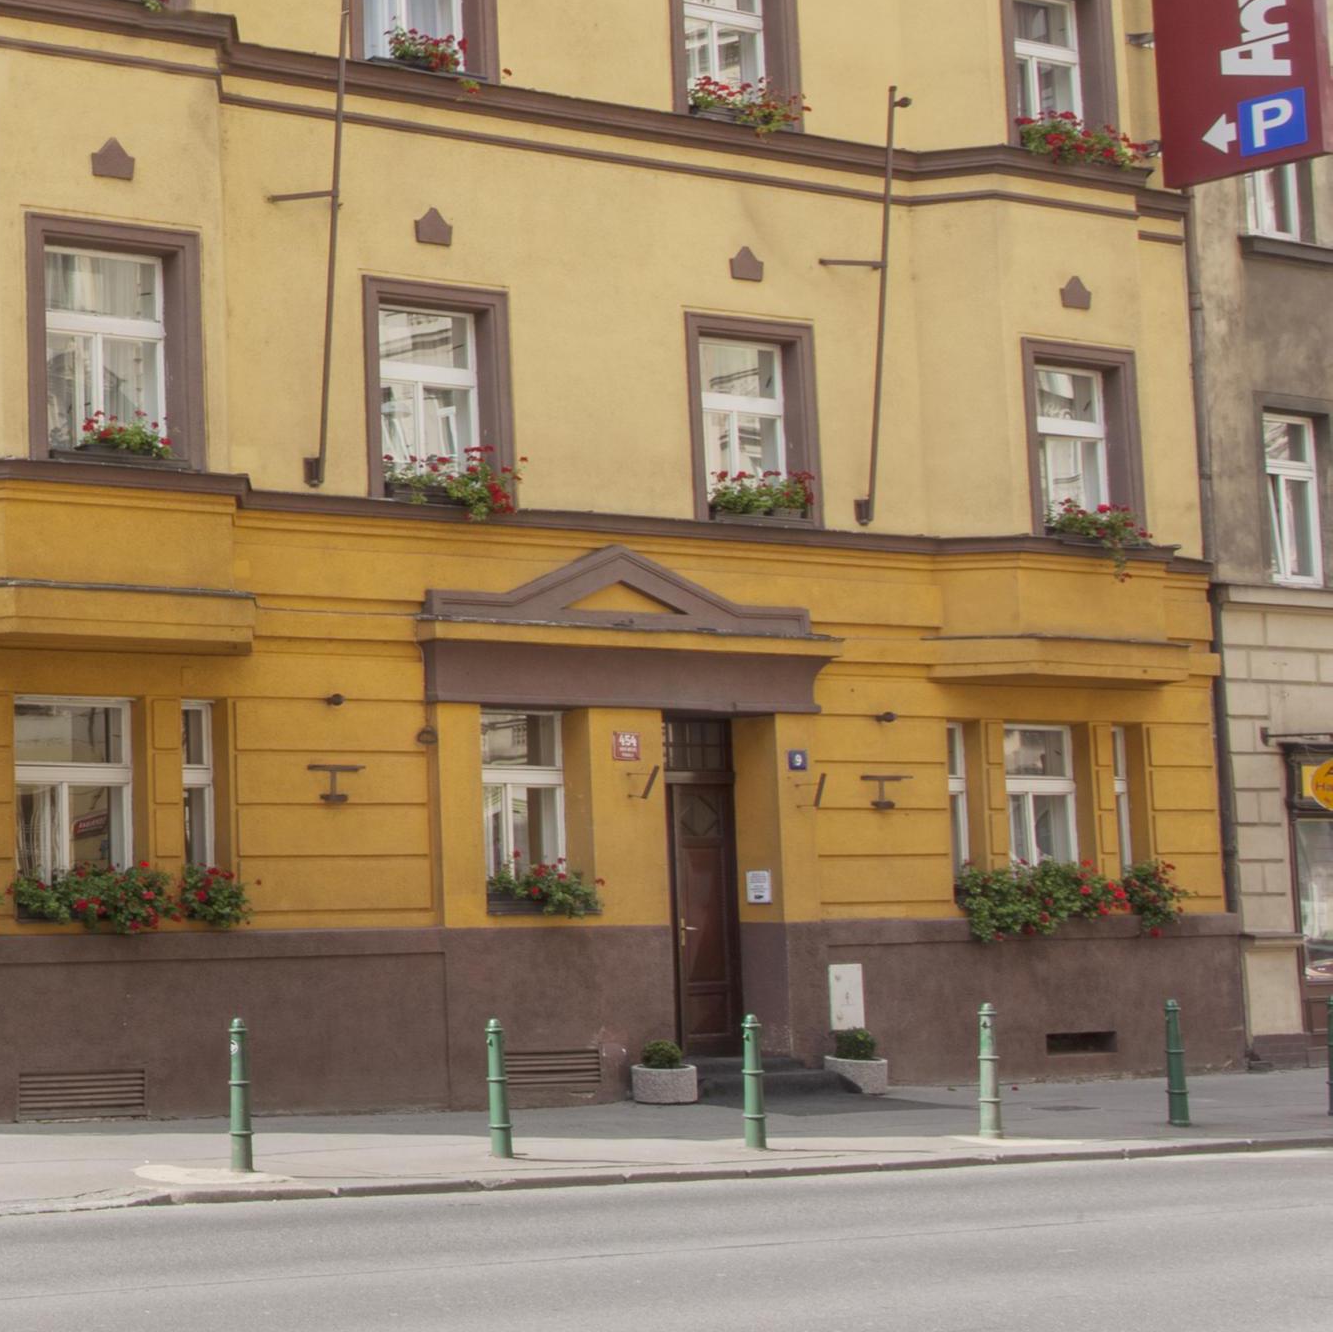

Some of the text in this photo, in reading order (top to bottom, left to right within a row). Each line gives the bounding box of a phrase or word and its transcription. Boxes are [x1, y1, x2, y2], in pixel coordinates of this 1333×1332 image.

[1251, 98, 1293, 148] P
[619, 734, 638, 747] 454
[795, 753, 803, 766] 9
